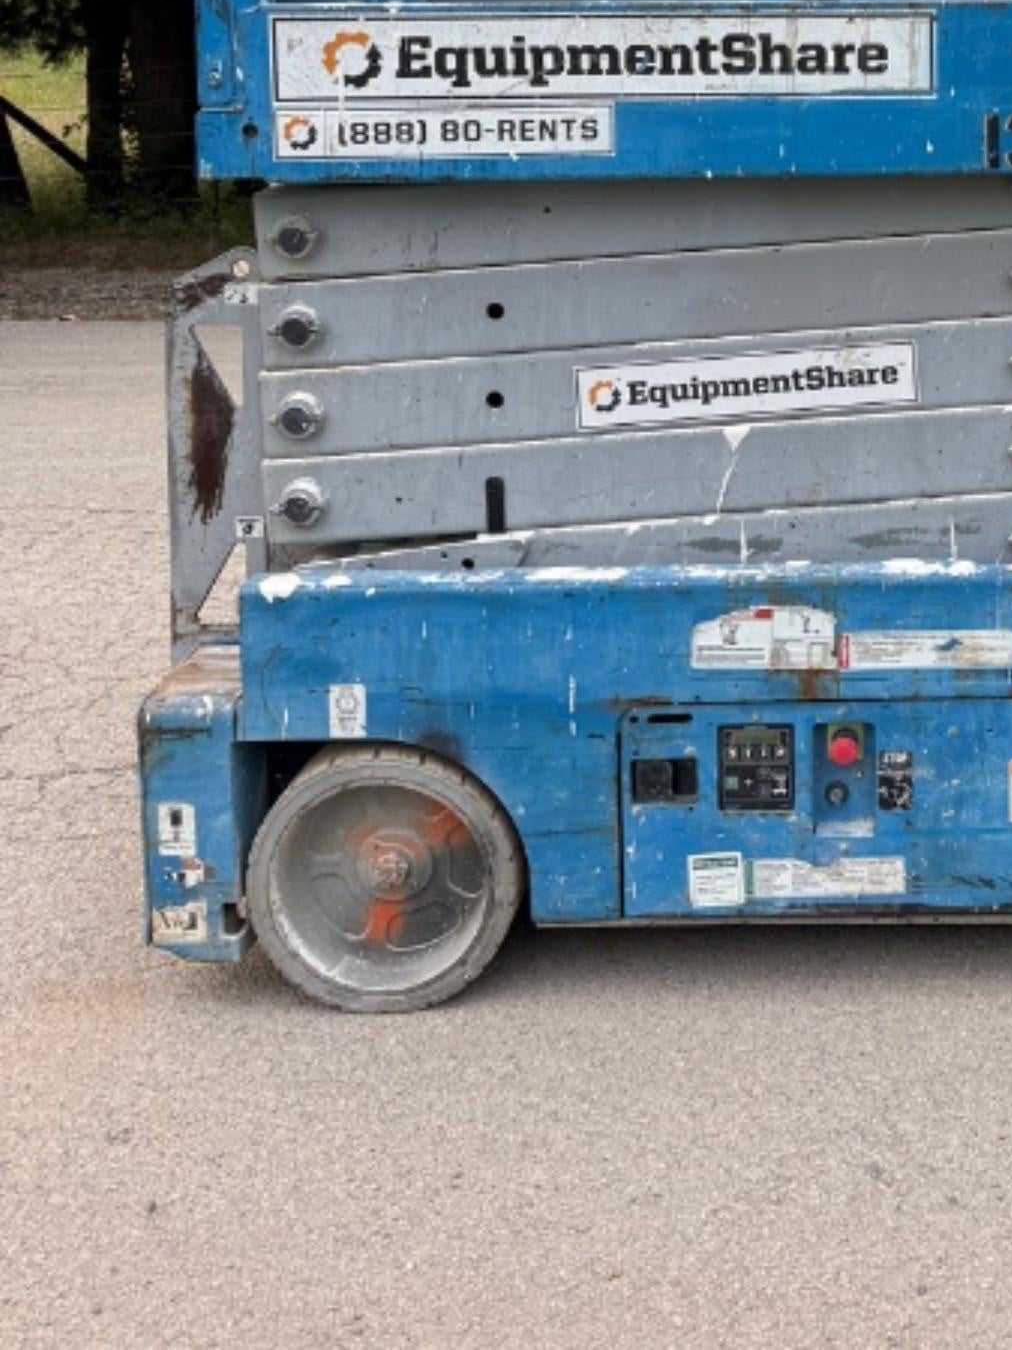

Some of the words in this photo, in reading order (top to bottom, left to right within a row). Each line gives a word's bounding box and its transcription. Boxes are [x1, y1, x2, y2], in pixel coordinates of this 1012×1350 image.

[396, 33, 888, 87] EquipmentShare
[338, 119, 427, 146] (888)
[440, 117, 599, 143] 80-RENTS
[626, 364, 899, 408] EquipmentShare
